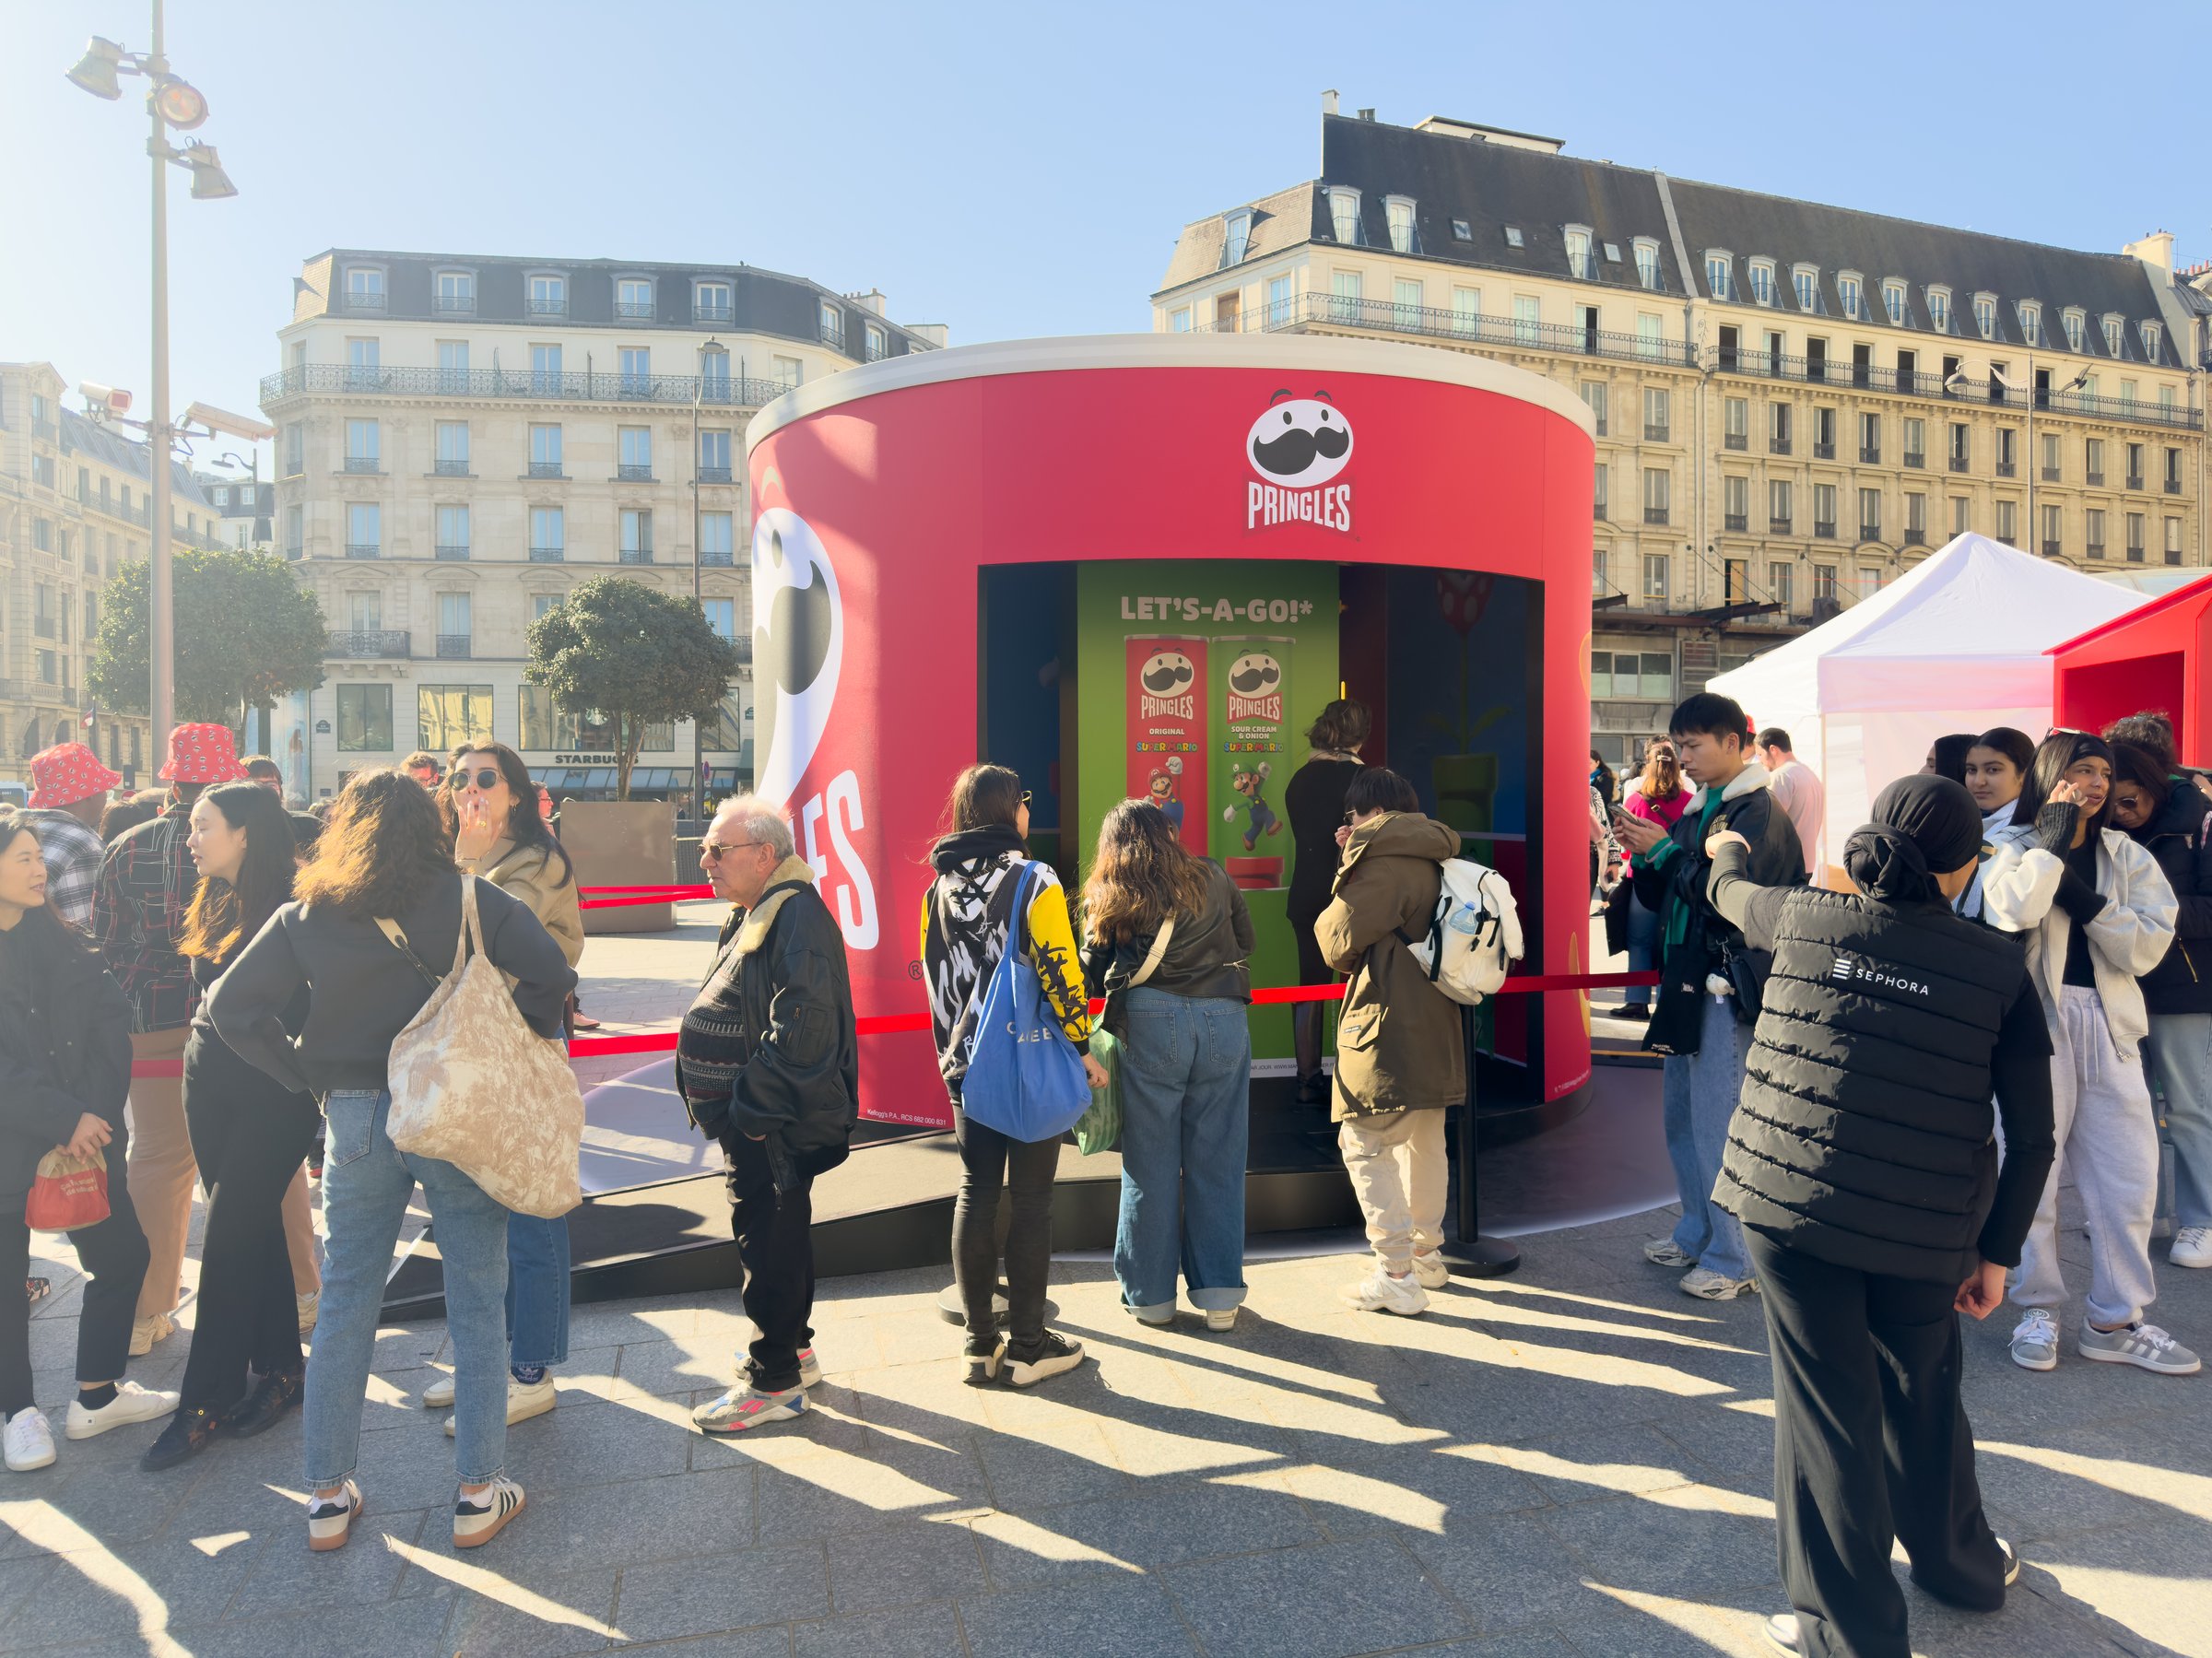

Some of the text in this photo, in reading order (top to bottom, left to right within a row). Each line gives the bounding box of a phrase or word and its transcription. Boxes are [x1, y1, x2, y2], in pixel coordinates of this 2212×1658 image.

[1248, 480, 1350, 532] PRINGLES
[1141, 694, 1194, 720] PRINGLES
[1229, 695, 1280, 721] PRINGLES
[1135, 742, 1166, 752] SUPER
[1223, 742, 1253, 752] SUPER
[1856, 968, 1929, 995] SEPHORA
[867, 1109, 888, 1119] Kellogg's
[900, 1113, 913, 1122] RCS
[913, 1115, 924, 1123] 682
